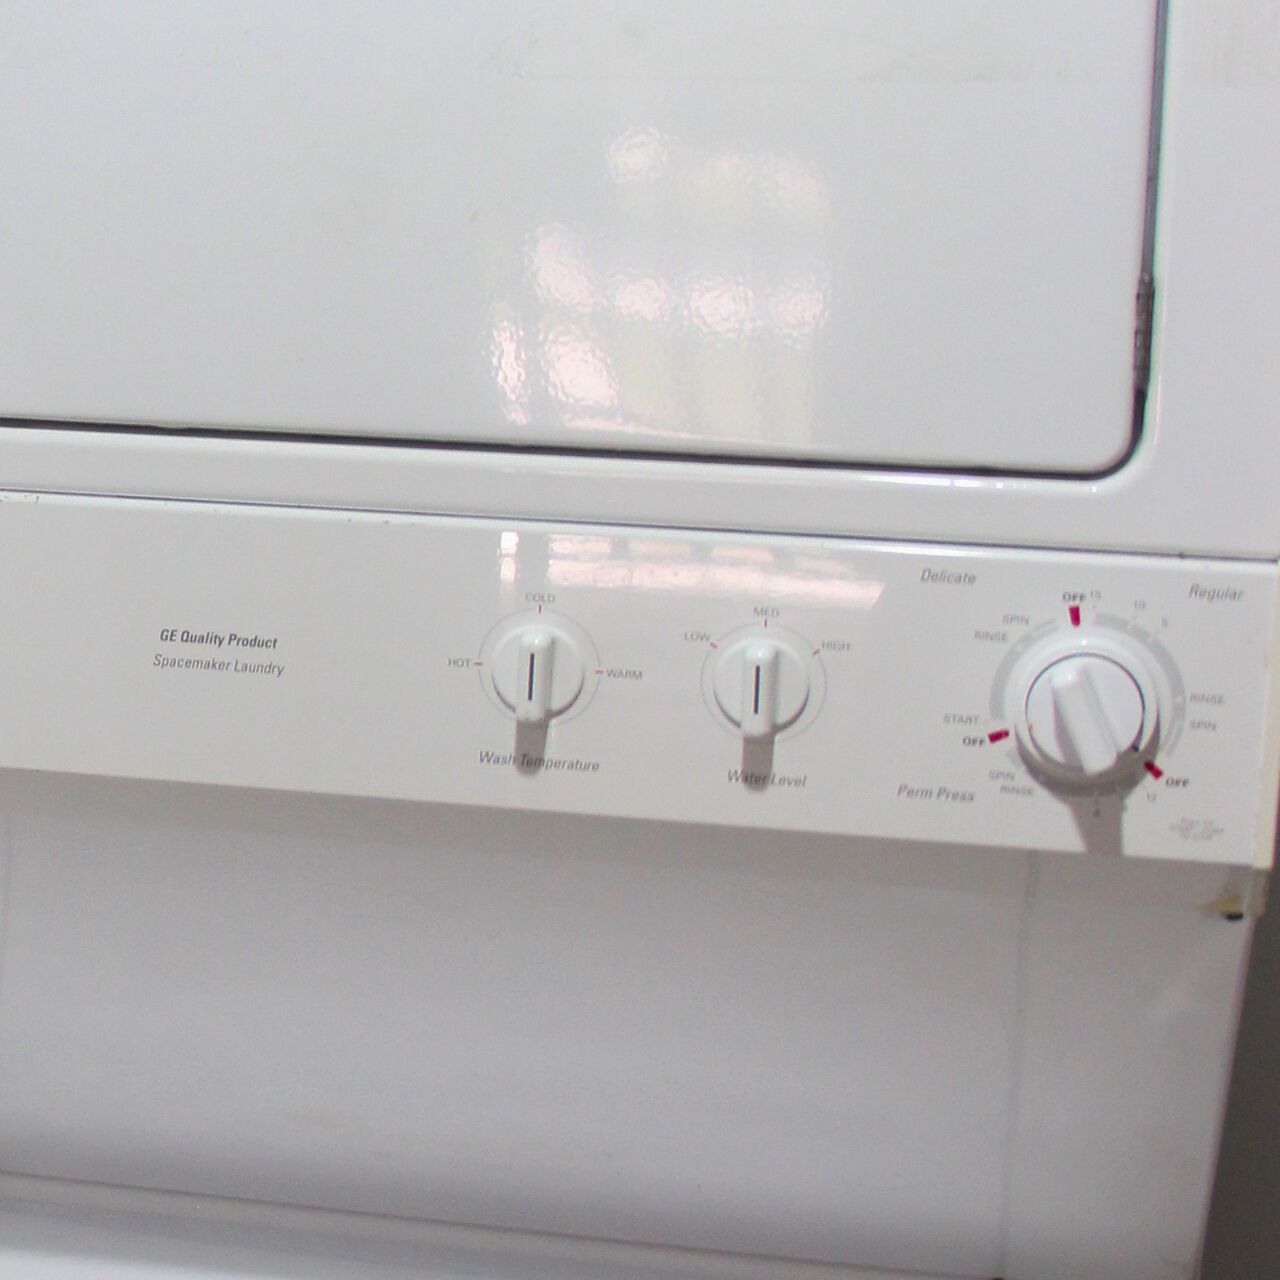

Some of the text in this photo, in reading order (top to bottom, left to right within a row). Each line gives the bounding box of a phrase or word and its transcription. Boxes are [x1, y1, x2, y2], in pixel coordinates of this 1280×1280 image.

[920, 567, 977, 584] Delicate
[525, 592, 556, 603] COLD
[1062, 590, 1086, 603] OFF
[1188, 582, 1245, 602] Regular
[160, 628, 278, 649] GE Quality Product
[684, 631, 712, 642] LOW
[821, 640, 851, 651] HIGH
[153, 653, 285, 678] Spacemaker Laundry
[448, 658, 471, 668] HOT
[606, 669, 643, 680] WARM
[962, 736, 986, 747] OFF
[478, 750, 600, 772] Wash Temperature
[727, 769, 807, 788] Water Level
[1165, 776, 1189, 787] OFF
[896, 783, 975, 802] Perm Press
